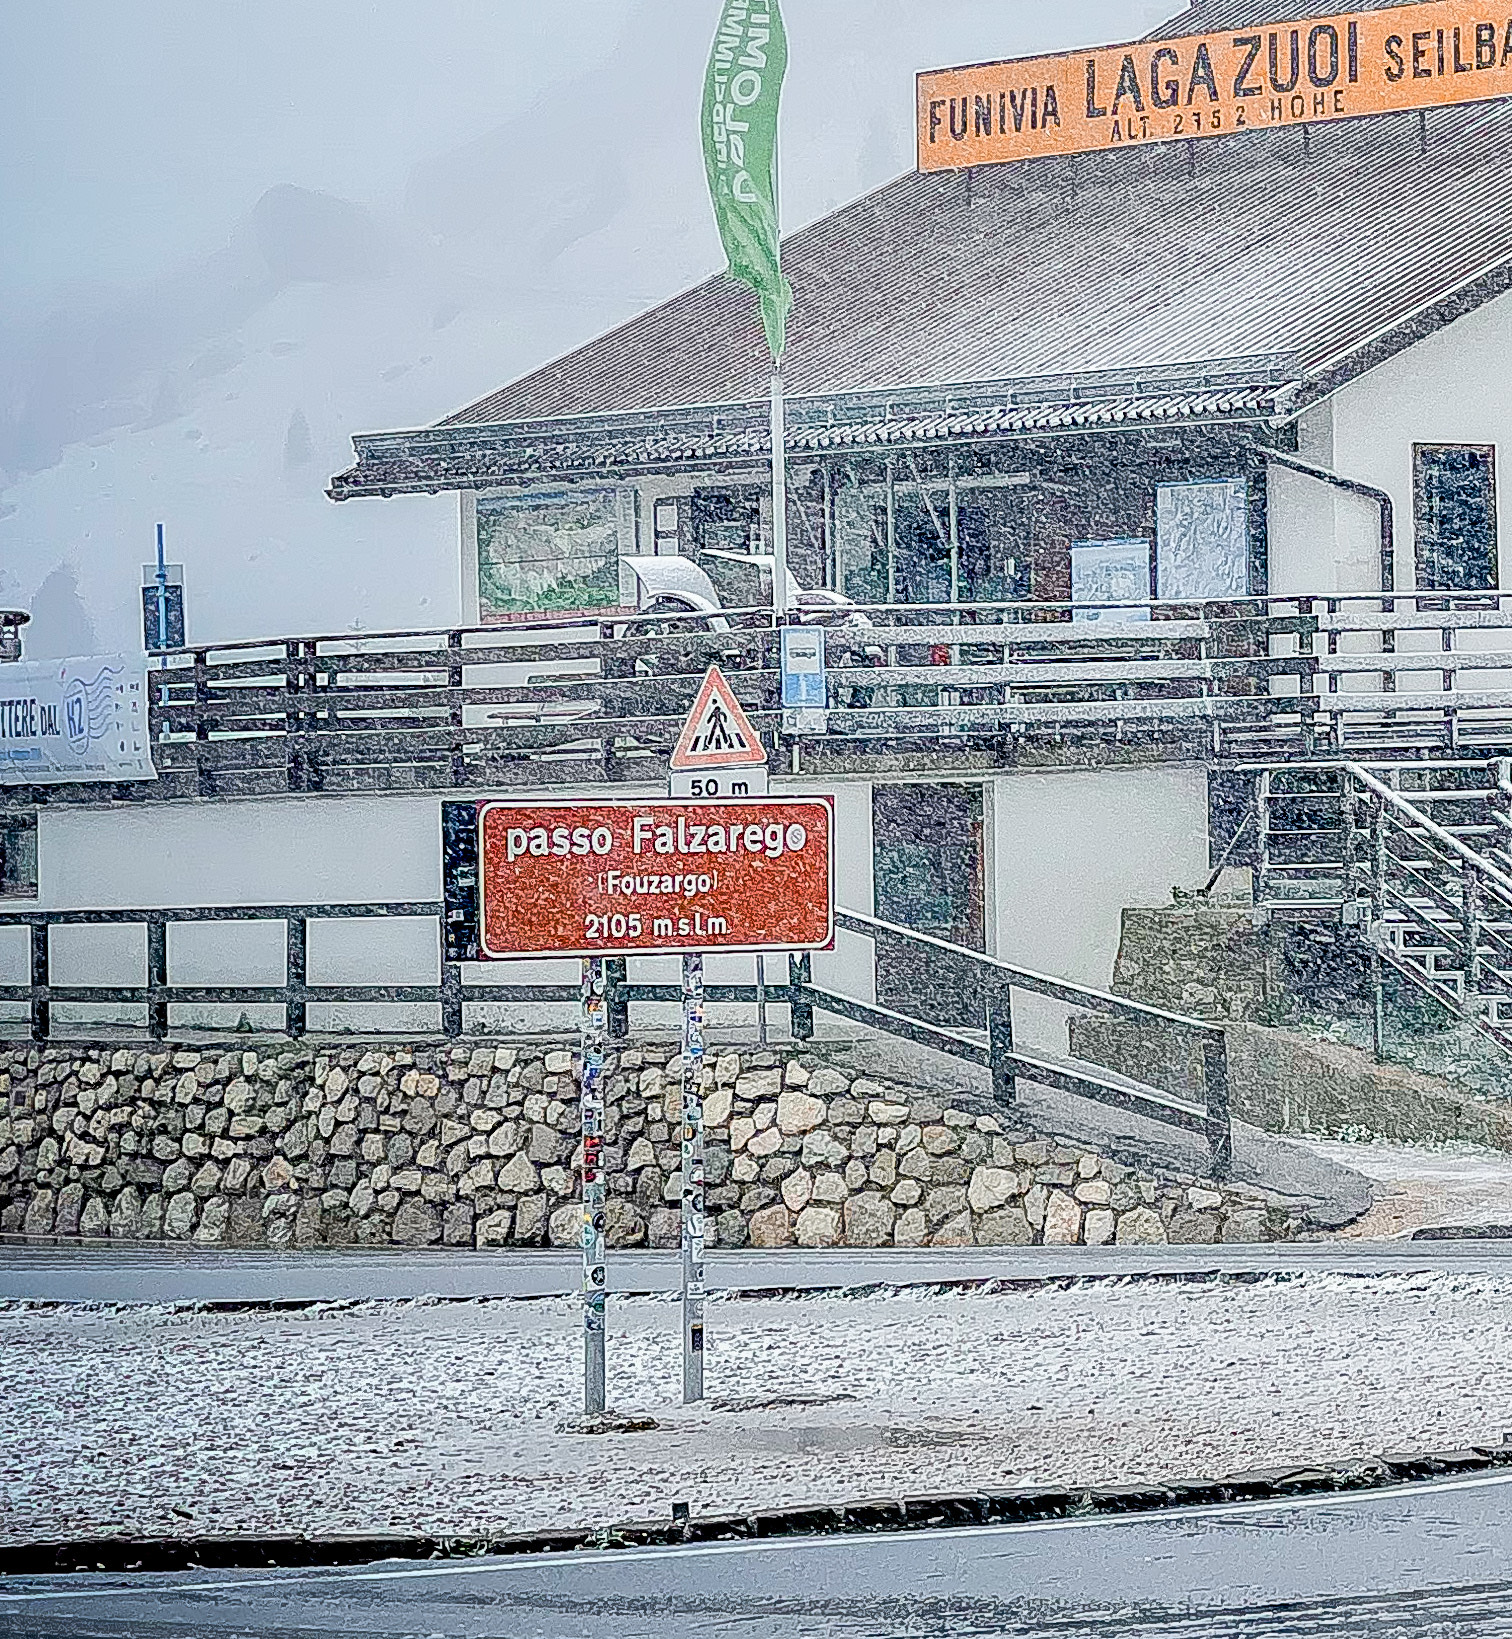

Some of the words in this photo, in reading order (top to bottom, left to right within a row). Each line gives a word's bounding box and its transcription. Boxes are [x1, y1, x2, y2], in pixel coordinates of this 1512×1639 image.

[930, 85, 1060, 143] FUNIVIA
[1086, 20, 1358, 118] LAGAZUOI
[40, 704, 61, 736] DAL
[691, 779, 719, 796] 50
[731, 781, 749, 796] m
[507, 826, 613, 862] passo
[633, 816, 807, 859] Falzarego
[597, 869, 719, 897] (Fouzargo)
[585, 913, 642, 939] 2105
